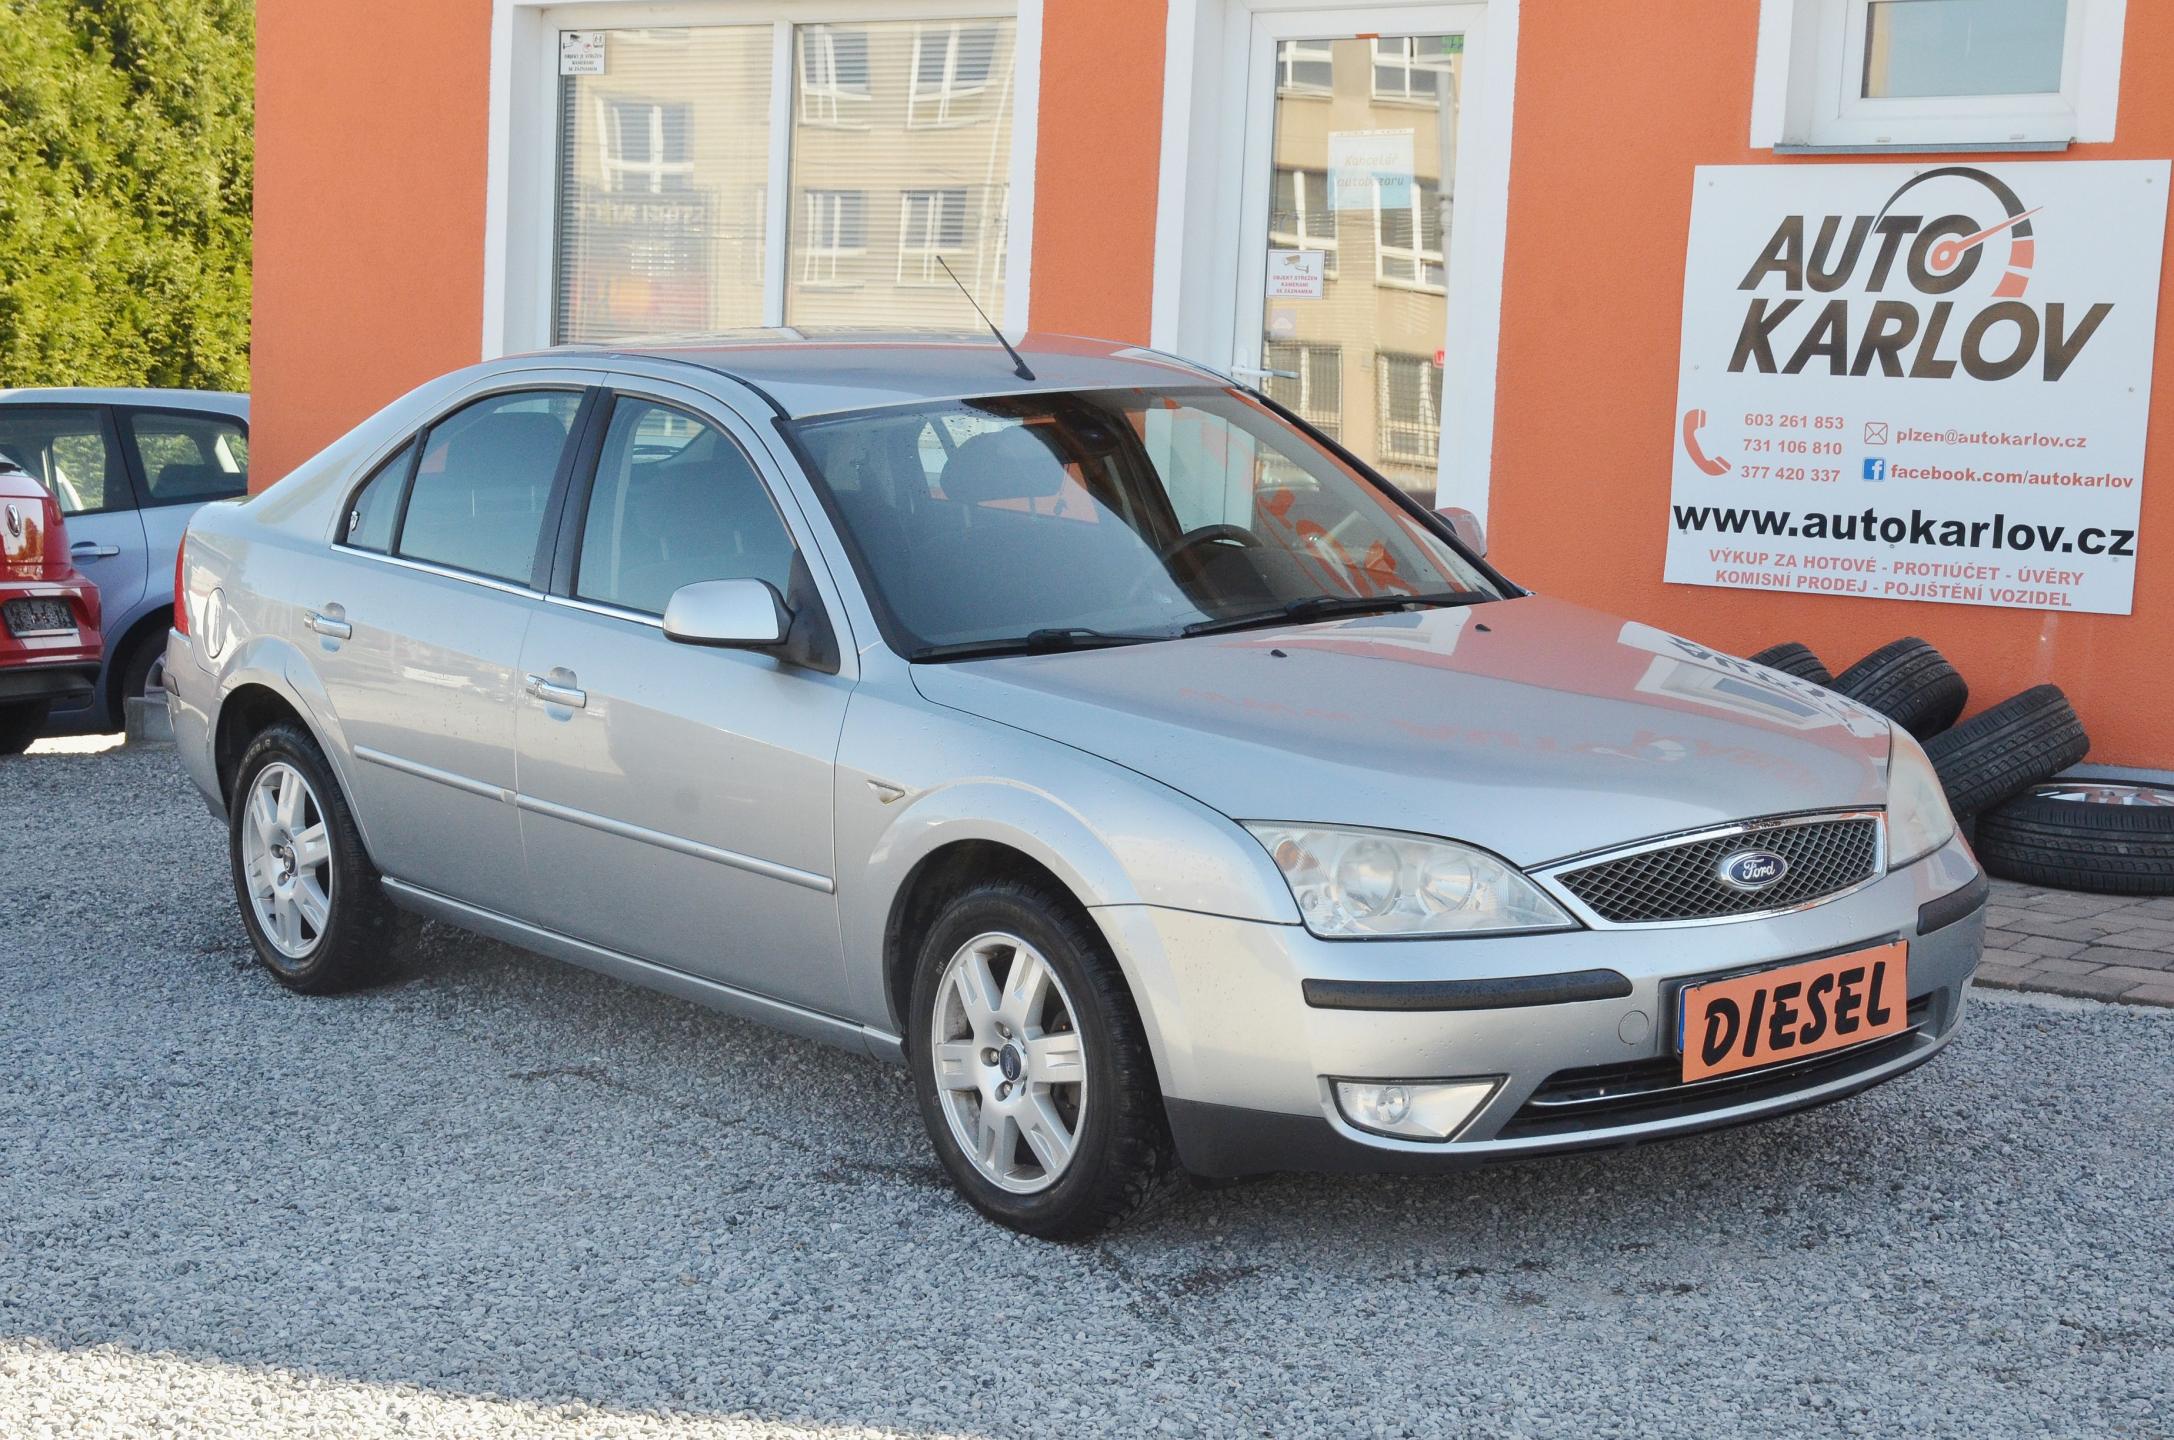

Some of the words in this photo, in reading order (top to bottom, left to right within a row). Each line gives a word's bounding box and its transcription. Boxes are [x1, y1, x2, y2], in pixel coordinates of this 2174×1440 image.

[1737, 214, 1984, 294] AUTO
[1727, 298, 2115, 382] KARLOV
[1744, 413, 1774, 427] 603
[1779, 414, 1807, 428] 261
[1814, 416, 1844, 430] 853
[1743, 438, 1771, 452] 731
[1778, 440, 1806, 454] 106
[1812, 441, 1842, 455] 810
[1896, 428, 2087, 448] plzen@autokarlov.cz
[1741, 465, 1769, 479] 377
[1775, 467, 1805, 481] 420
[1811, 469, 1840, 482] 337
[1891, 464, 2133, 488] facebook.com/autokarlov
[1673, 505, 2135, 556] www.autokarlov.cz
[1709, 548, 1769, 565] VÝKUP
[1774, 553, 1797, 568] ZA
[1803, 555, 1877, 573] HOTOVÉ
[1893, 561, 2000, 580] PROTIÚČET
[2017, 566, 2085, 586] ÚVĚRY
[1715, 570, 1791, 587] KOMISNÍ
[1797, 575, 1867, 593] PRODEJ
[1884, 581, 1983, 600] POJIŠTĚNÍ
[1990, 588, 2072, 606] VOZIDEL
[1742, 858, 1776, 880] Ford
[1701, 961, 1891, 1067] DIESEL
